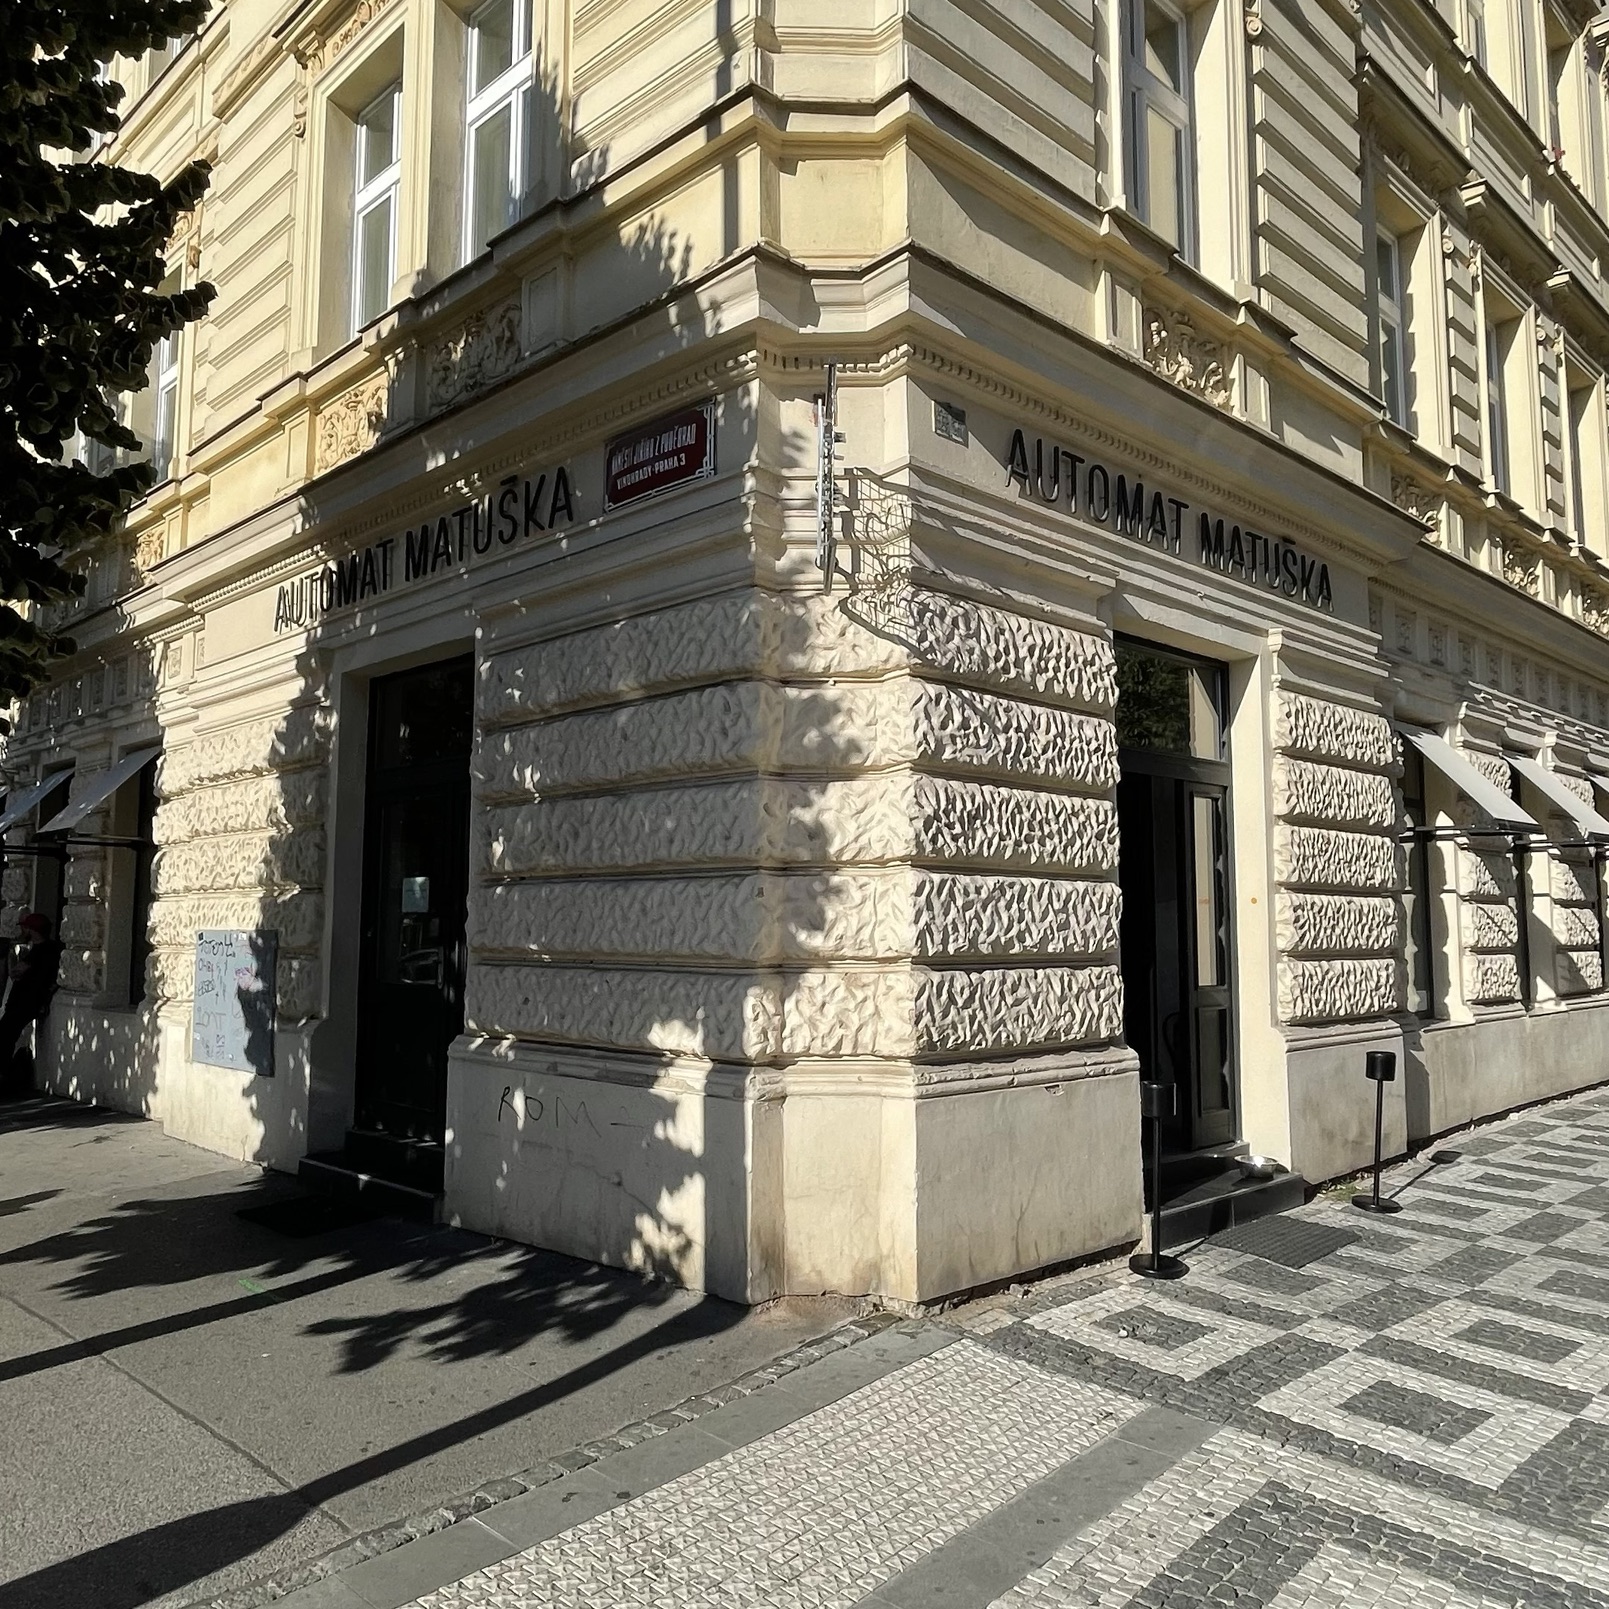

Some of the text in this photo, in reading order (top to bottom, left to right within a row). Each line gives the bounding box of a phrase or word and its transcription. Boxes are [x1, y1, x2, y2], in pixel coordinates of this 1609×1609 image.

[679, 453, 686, 466] 3
[1005, 428, 1335, 612] AUTOMAT MATUŠKA
[273, 466, 574, 632] AUTOMAT MATUŠKA
